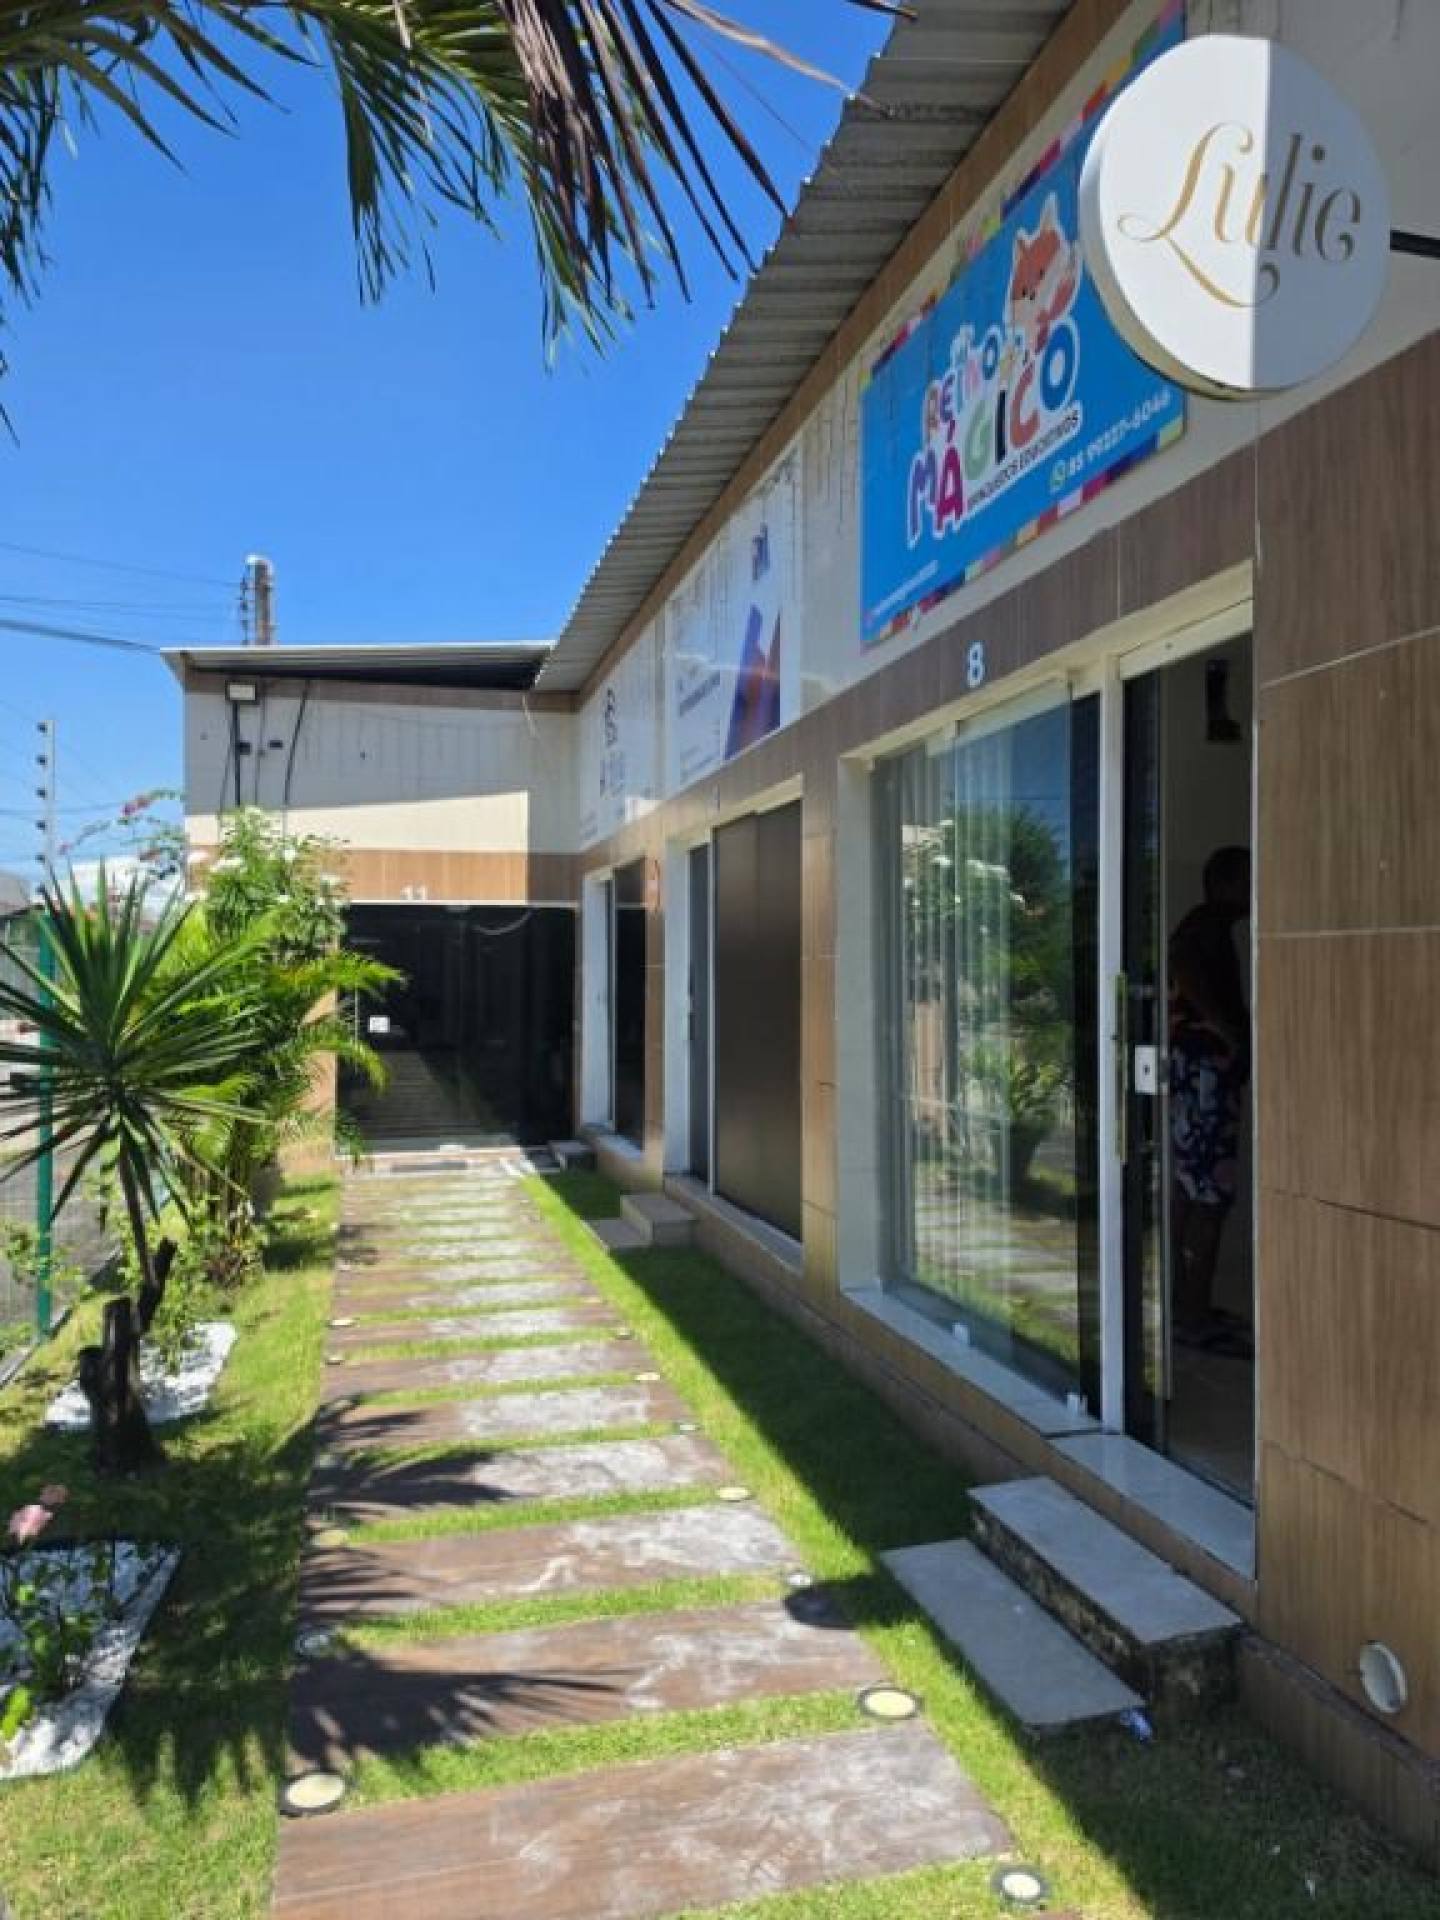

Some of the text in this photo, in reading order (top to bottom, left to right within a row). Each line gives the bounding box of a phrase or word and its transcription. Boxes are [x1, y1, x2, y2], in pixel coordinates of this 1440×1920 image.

[1118, 122, 1361, 307] Lulie
[911, 323, 1076, 541] MÁGICO
[928, 332, 999, 434] REINO
[967, 641, 985, 688] 8
